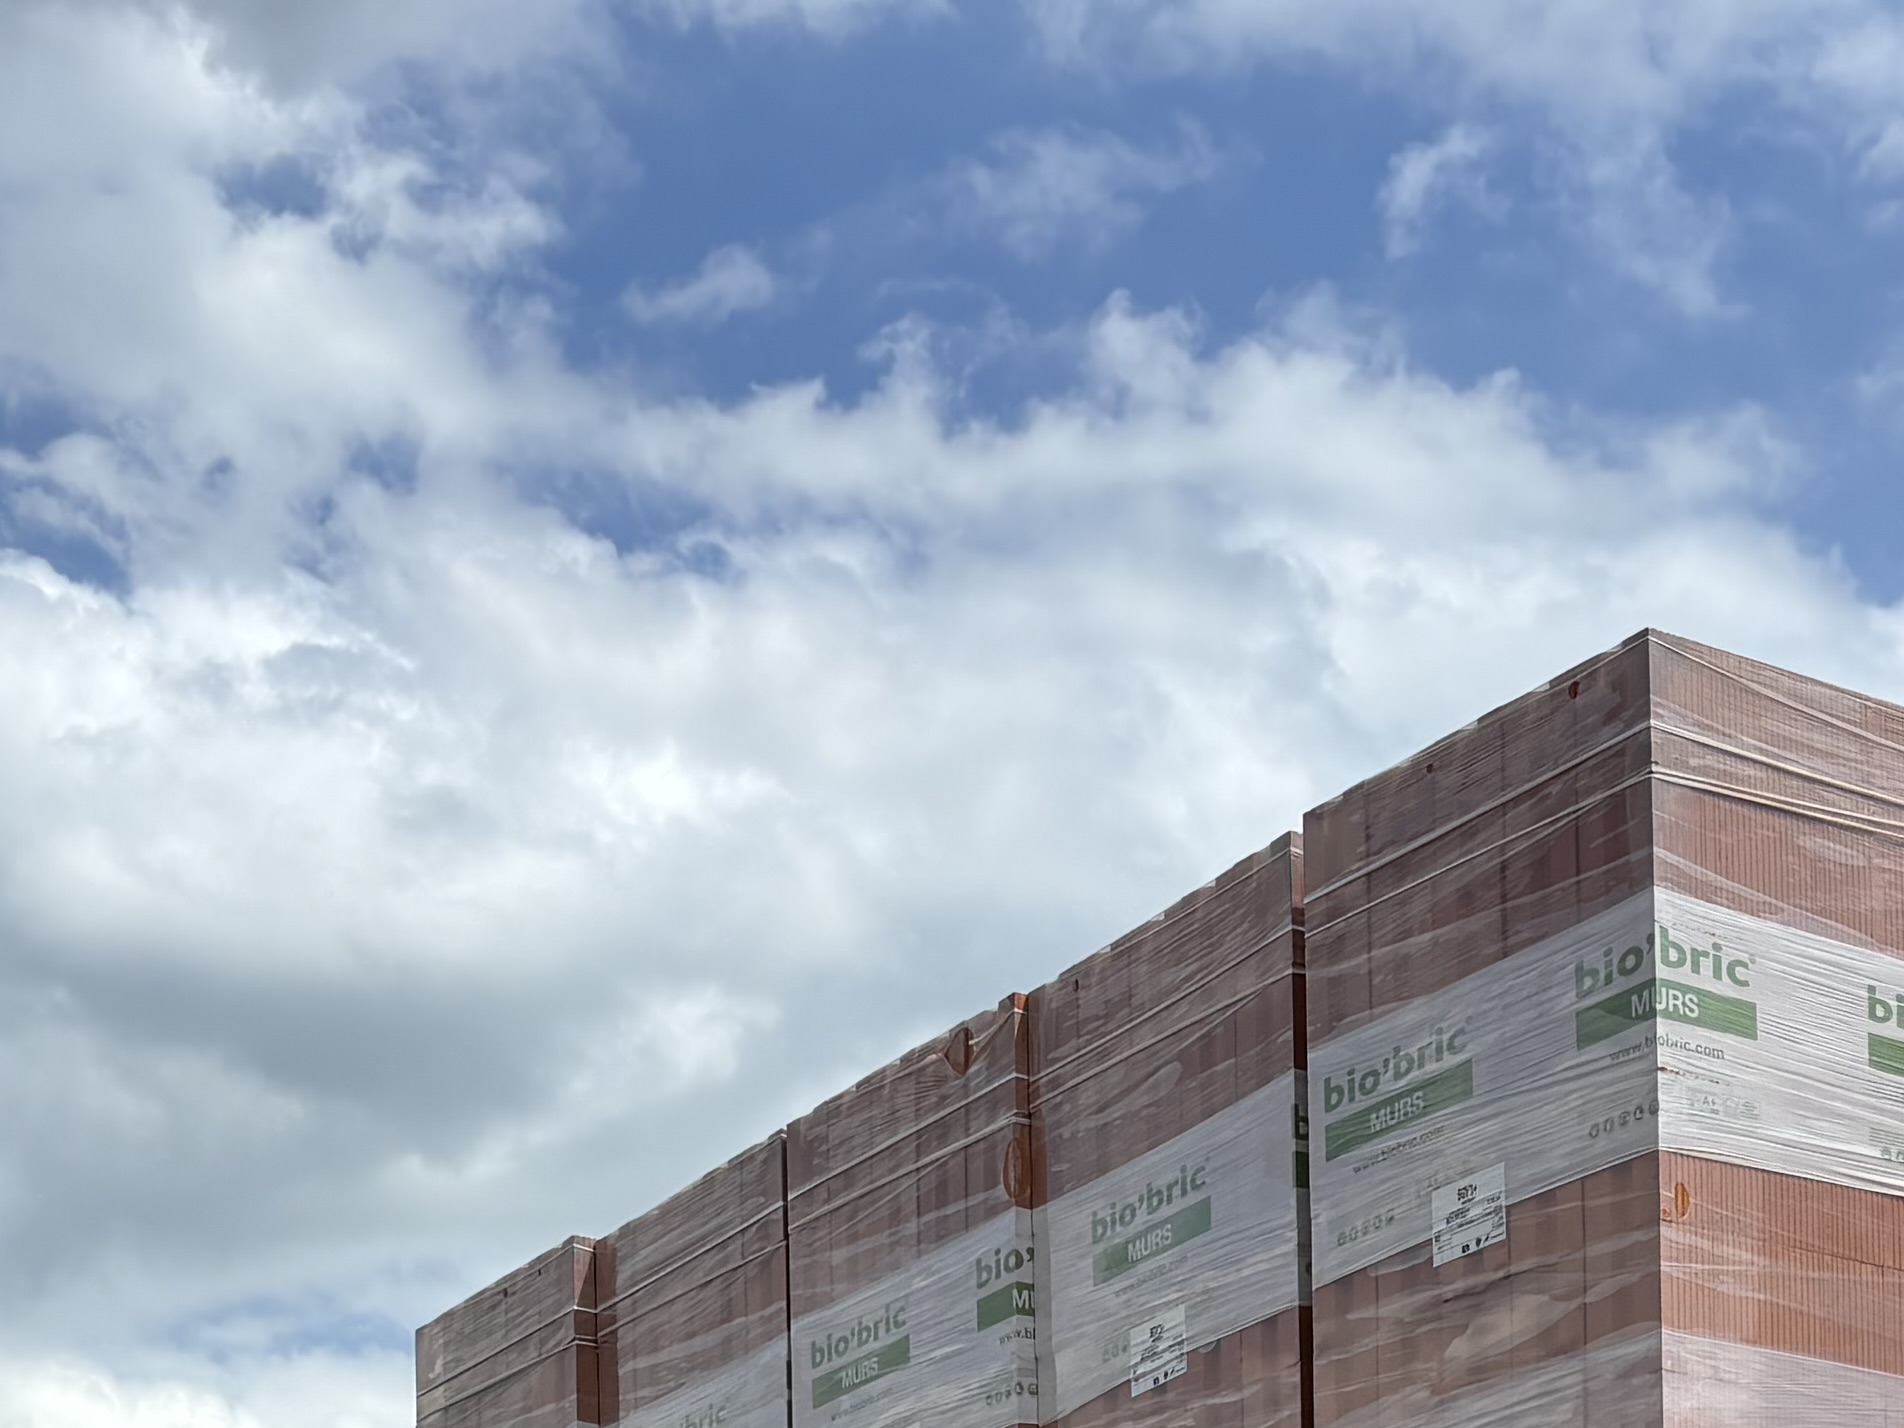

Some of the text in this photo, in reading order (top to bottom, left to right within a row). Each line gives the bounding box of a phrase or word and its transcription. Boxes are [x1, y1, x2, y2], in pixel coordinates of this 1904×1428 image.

[1631, 987, 1700, 1018] MURS
[1128, 1224, 1172, 1263] MURS
[840, 1356, 879, 1390] MURS
